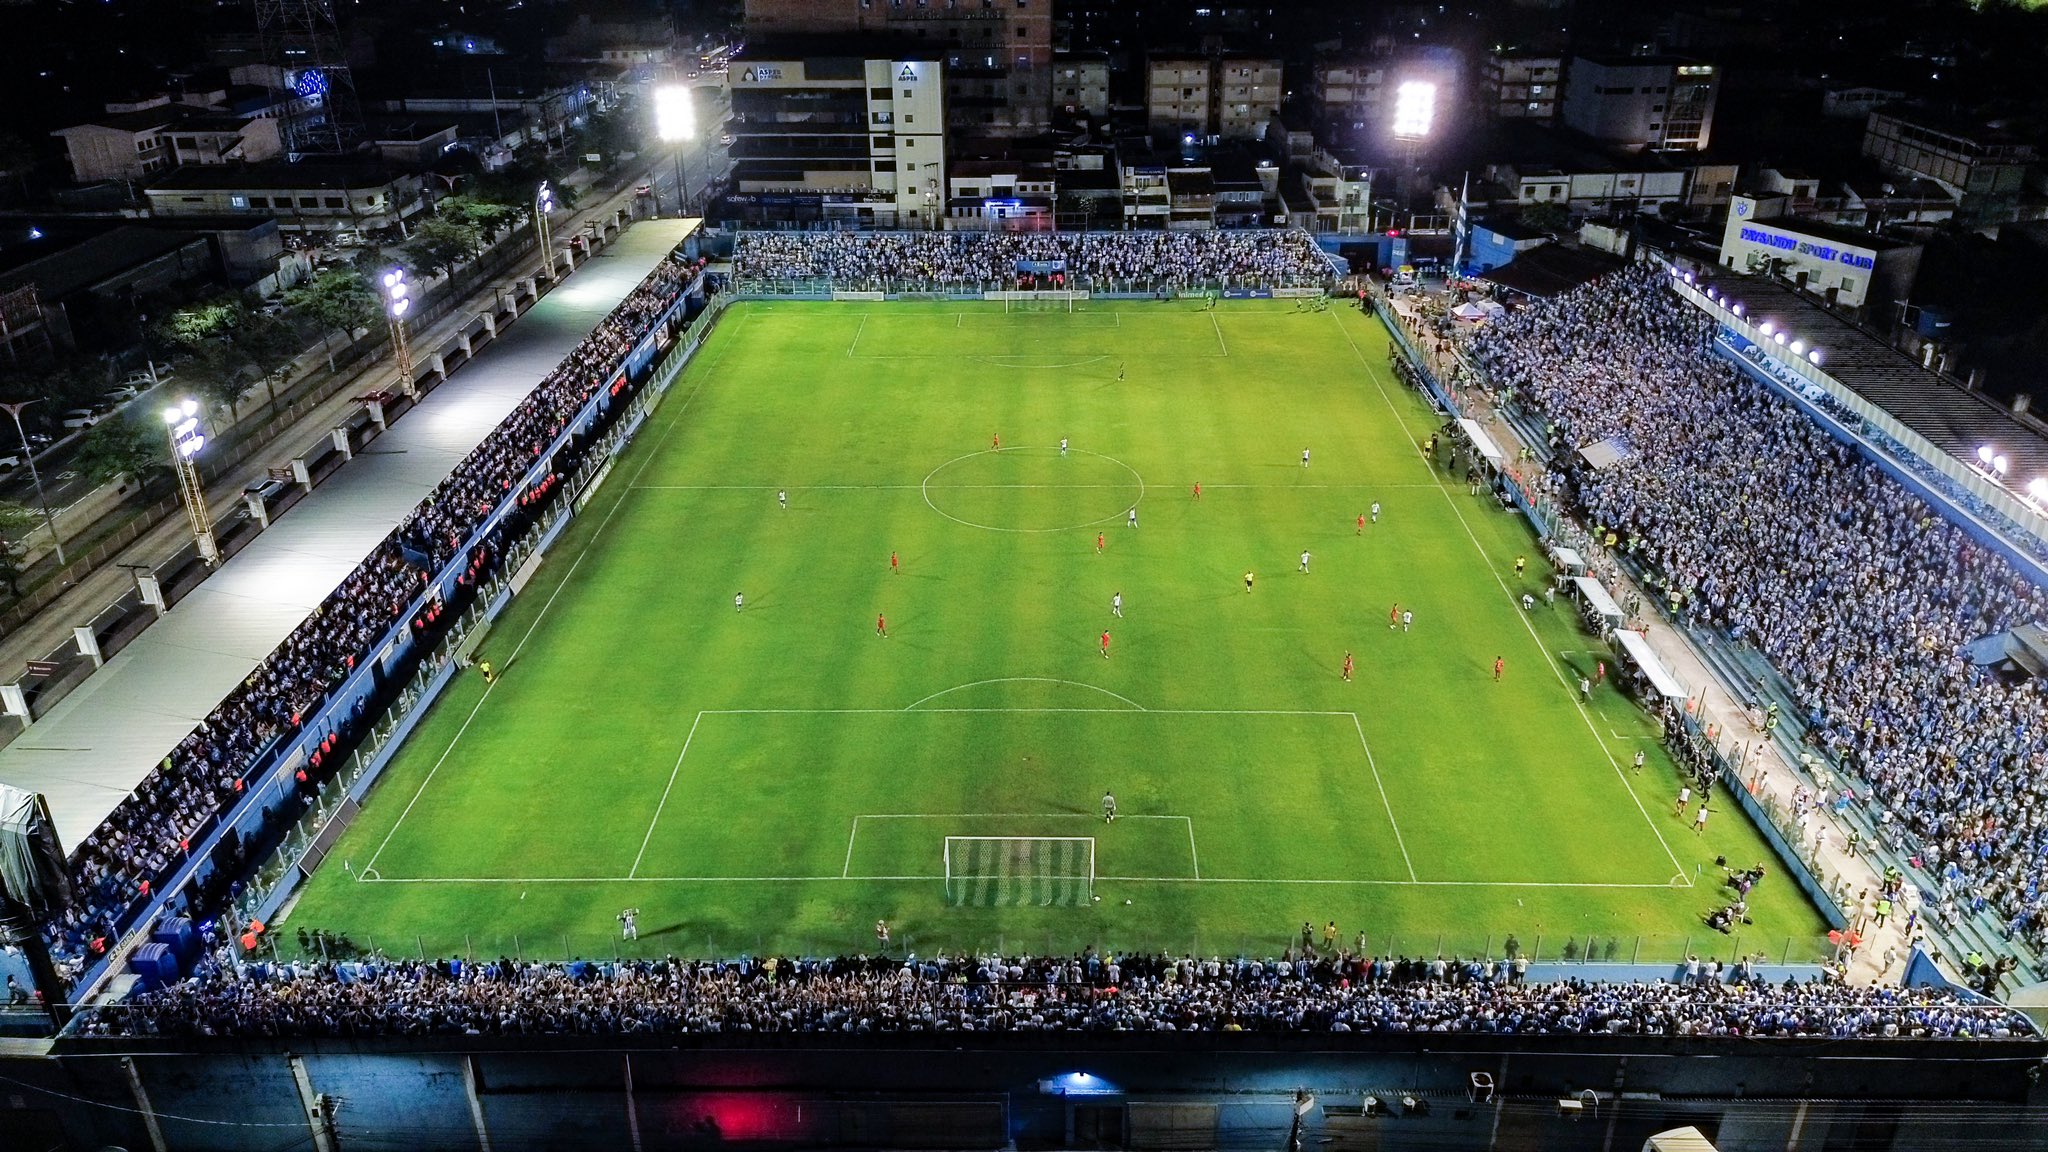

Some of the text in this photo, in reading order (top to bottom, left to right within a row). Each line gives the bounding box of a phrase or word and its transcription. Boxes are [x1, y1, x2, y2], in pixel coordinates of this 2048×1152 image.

[1741, 229, 1873, 269] PAYSANDU SPORT CLUB
